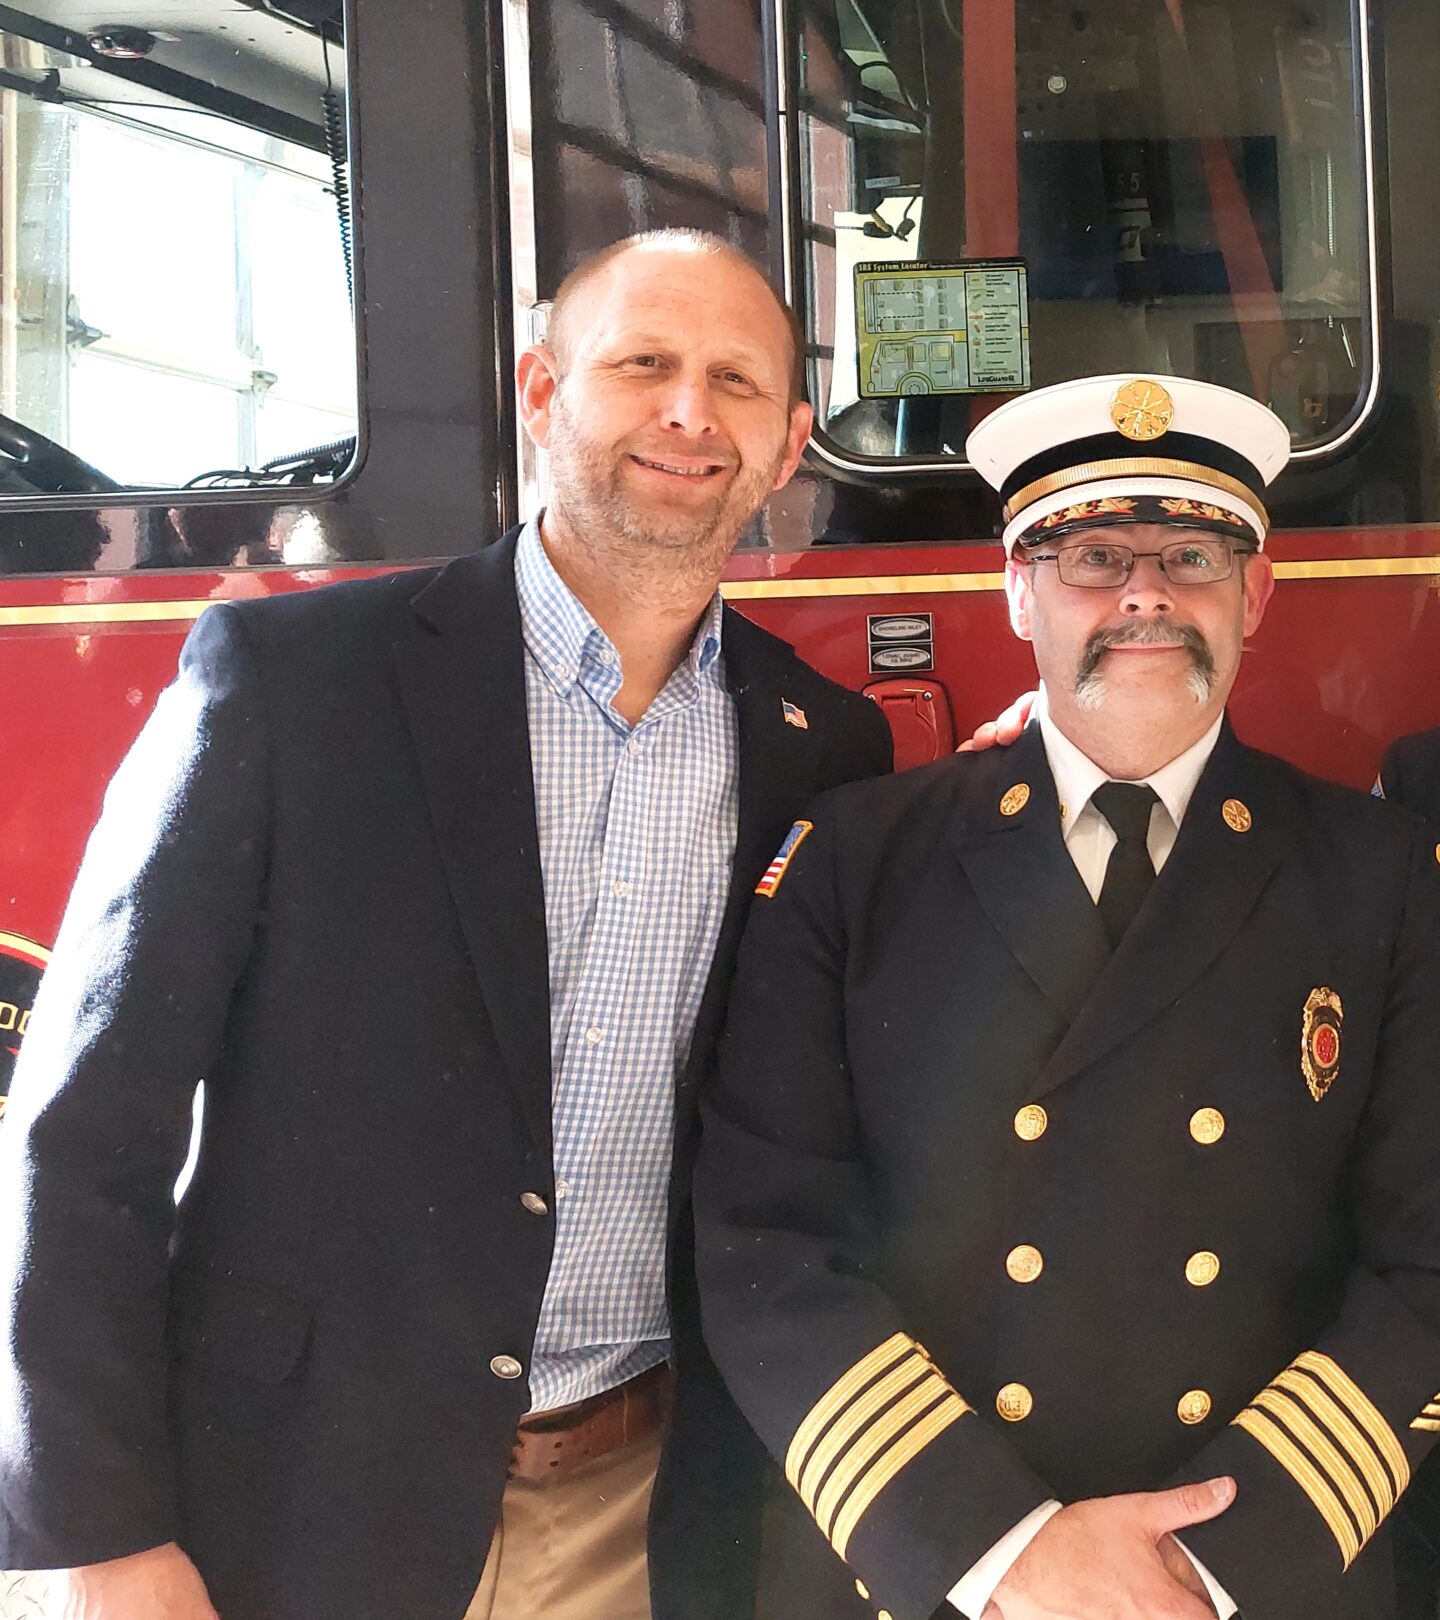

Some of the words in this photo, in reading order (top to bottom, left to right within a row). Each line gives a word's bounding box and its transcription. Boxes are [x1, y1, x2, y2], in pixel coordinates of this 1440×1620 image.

[859, 263, 872, 272] SRS
[873, 263, 900, 272] System
[901, 262, 928, 270] Locator
